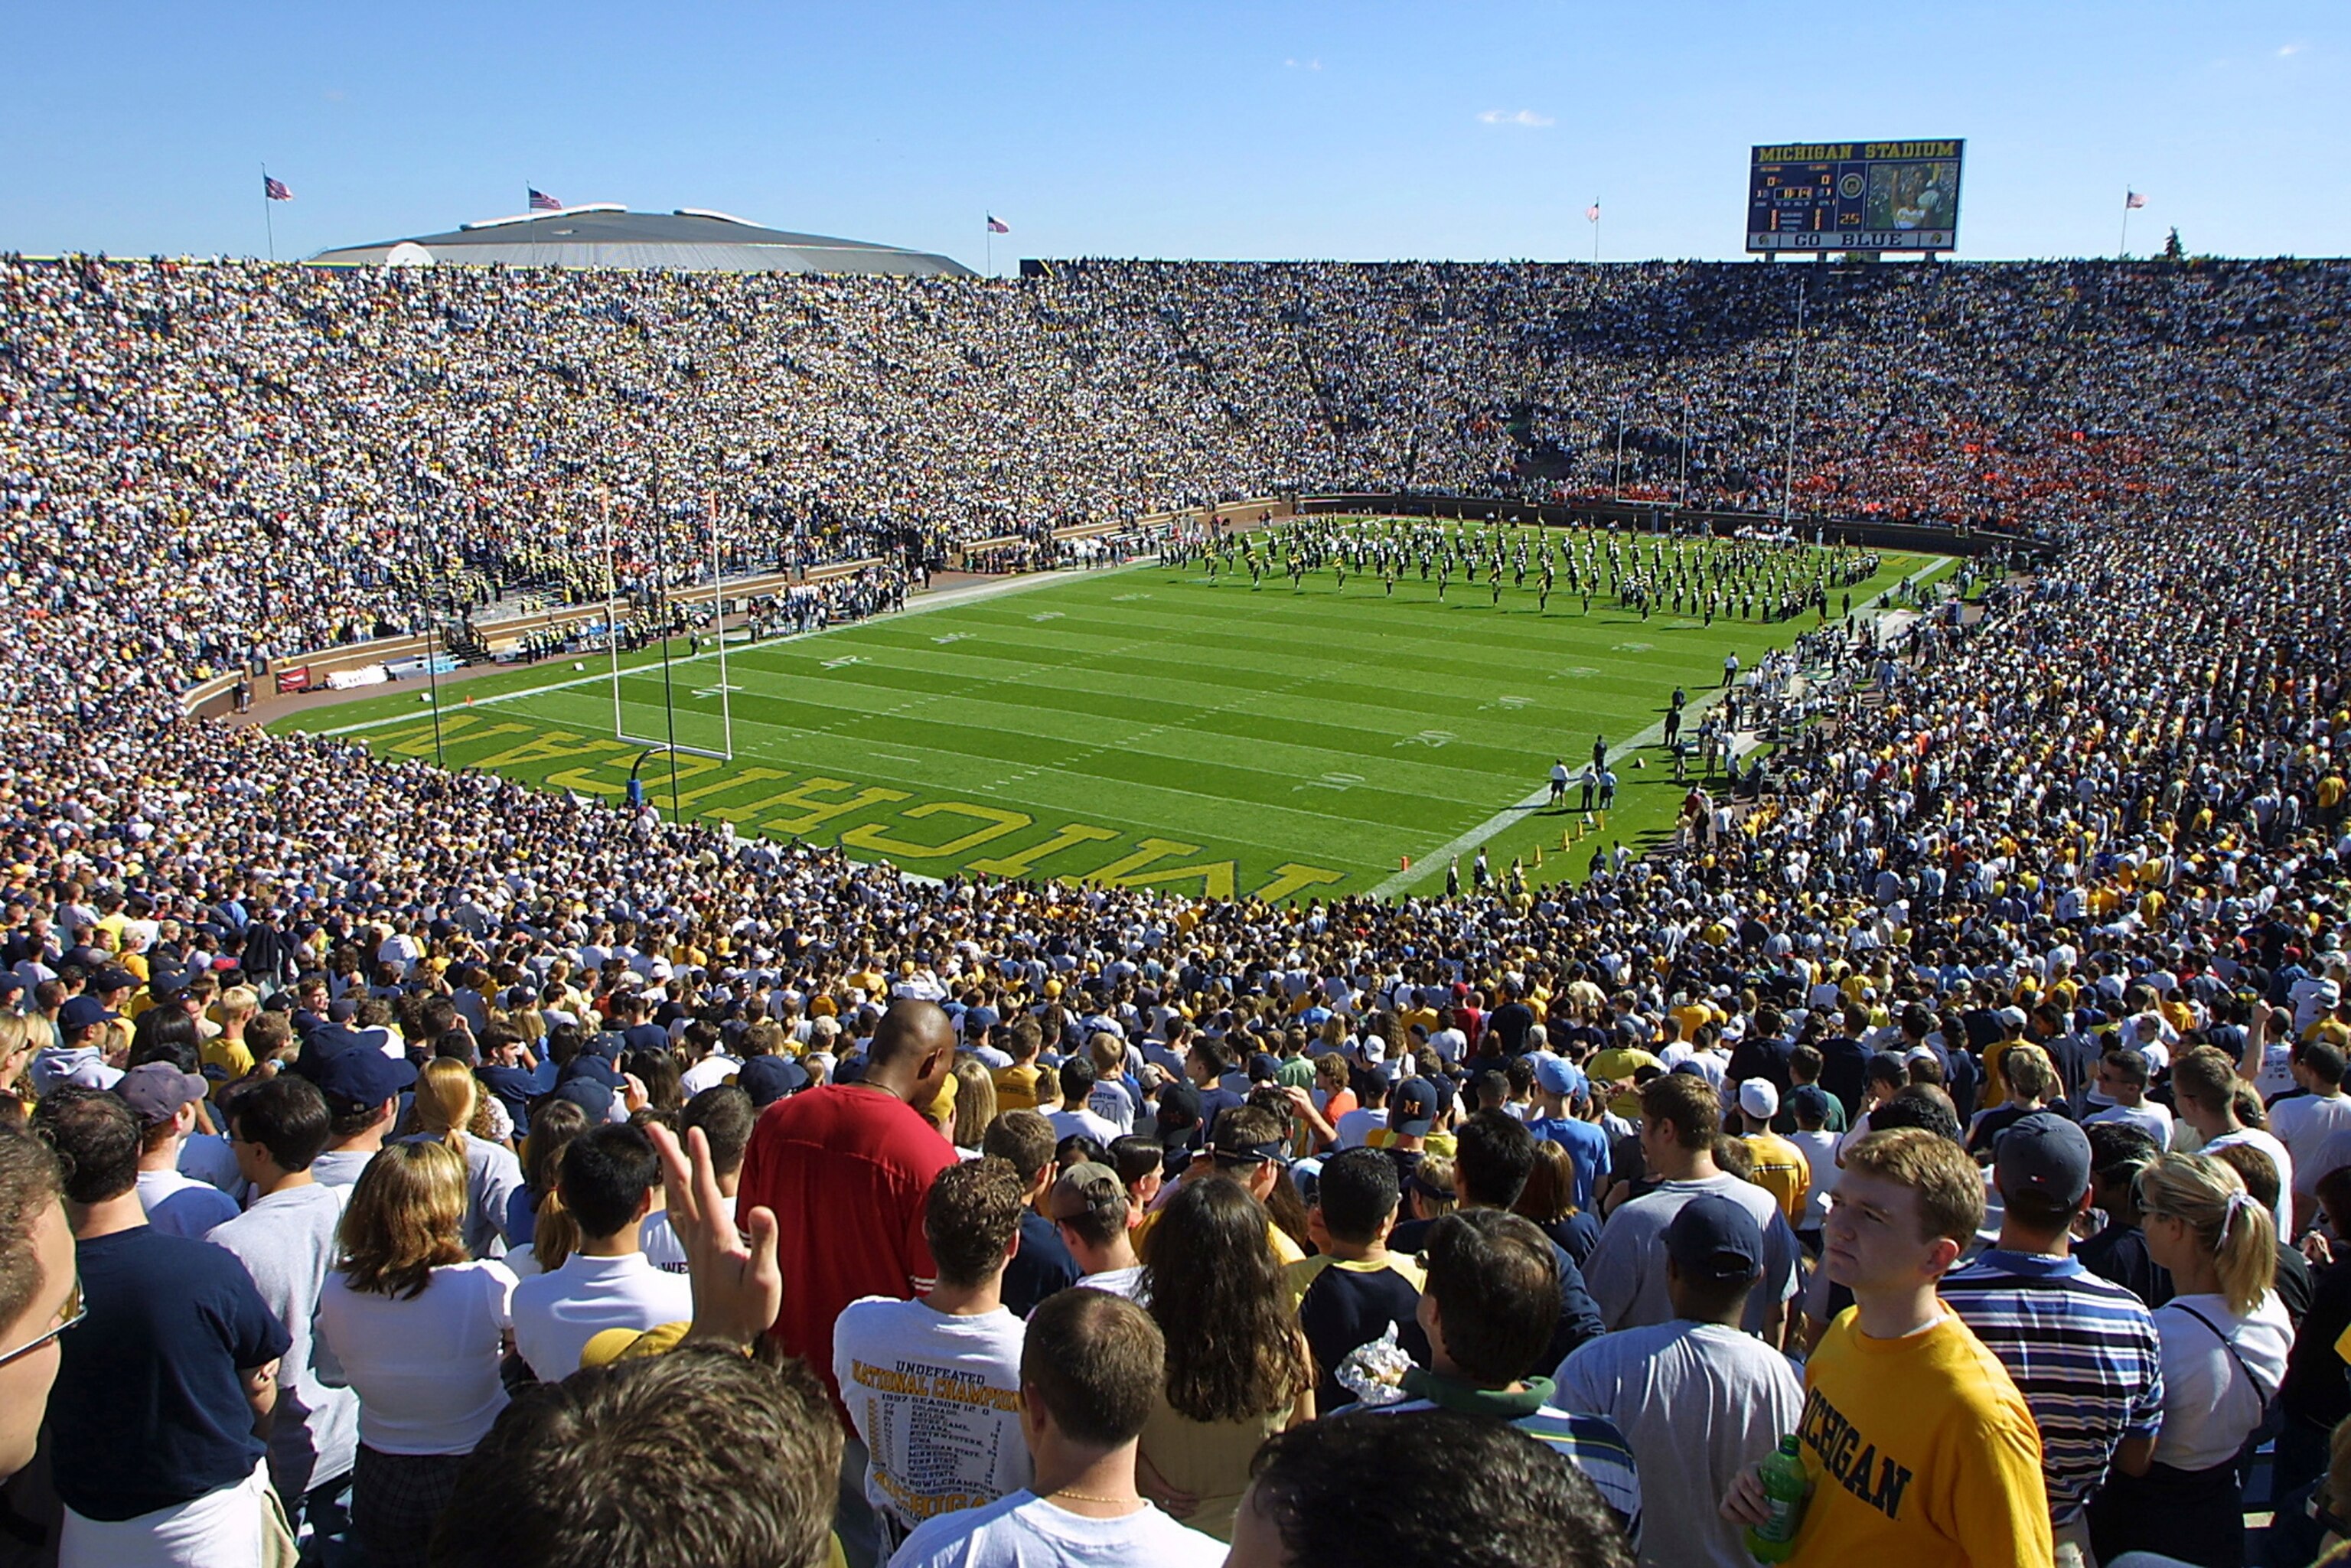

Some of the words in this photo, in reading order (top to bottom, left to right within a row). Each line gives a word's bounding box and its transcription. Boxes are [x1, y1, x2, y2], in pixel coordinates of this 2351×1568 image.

[1759, 145, 1853, 162] MICHIGAN
[1865, 141, 1955, 159] STADIUM
[1840, 213, 1860, 224] 25
[1795, 234, 1821, 246] GO
[1841, 233, 1903, 246] BLUE
[1403, 1099, 1420, 1115] M
[852, 1359, 928, 1397] NATIONAL
[896, 1361, 986, 1385] UNDEFEATED
[911, 1396, 960, 1410] SEASON
